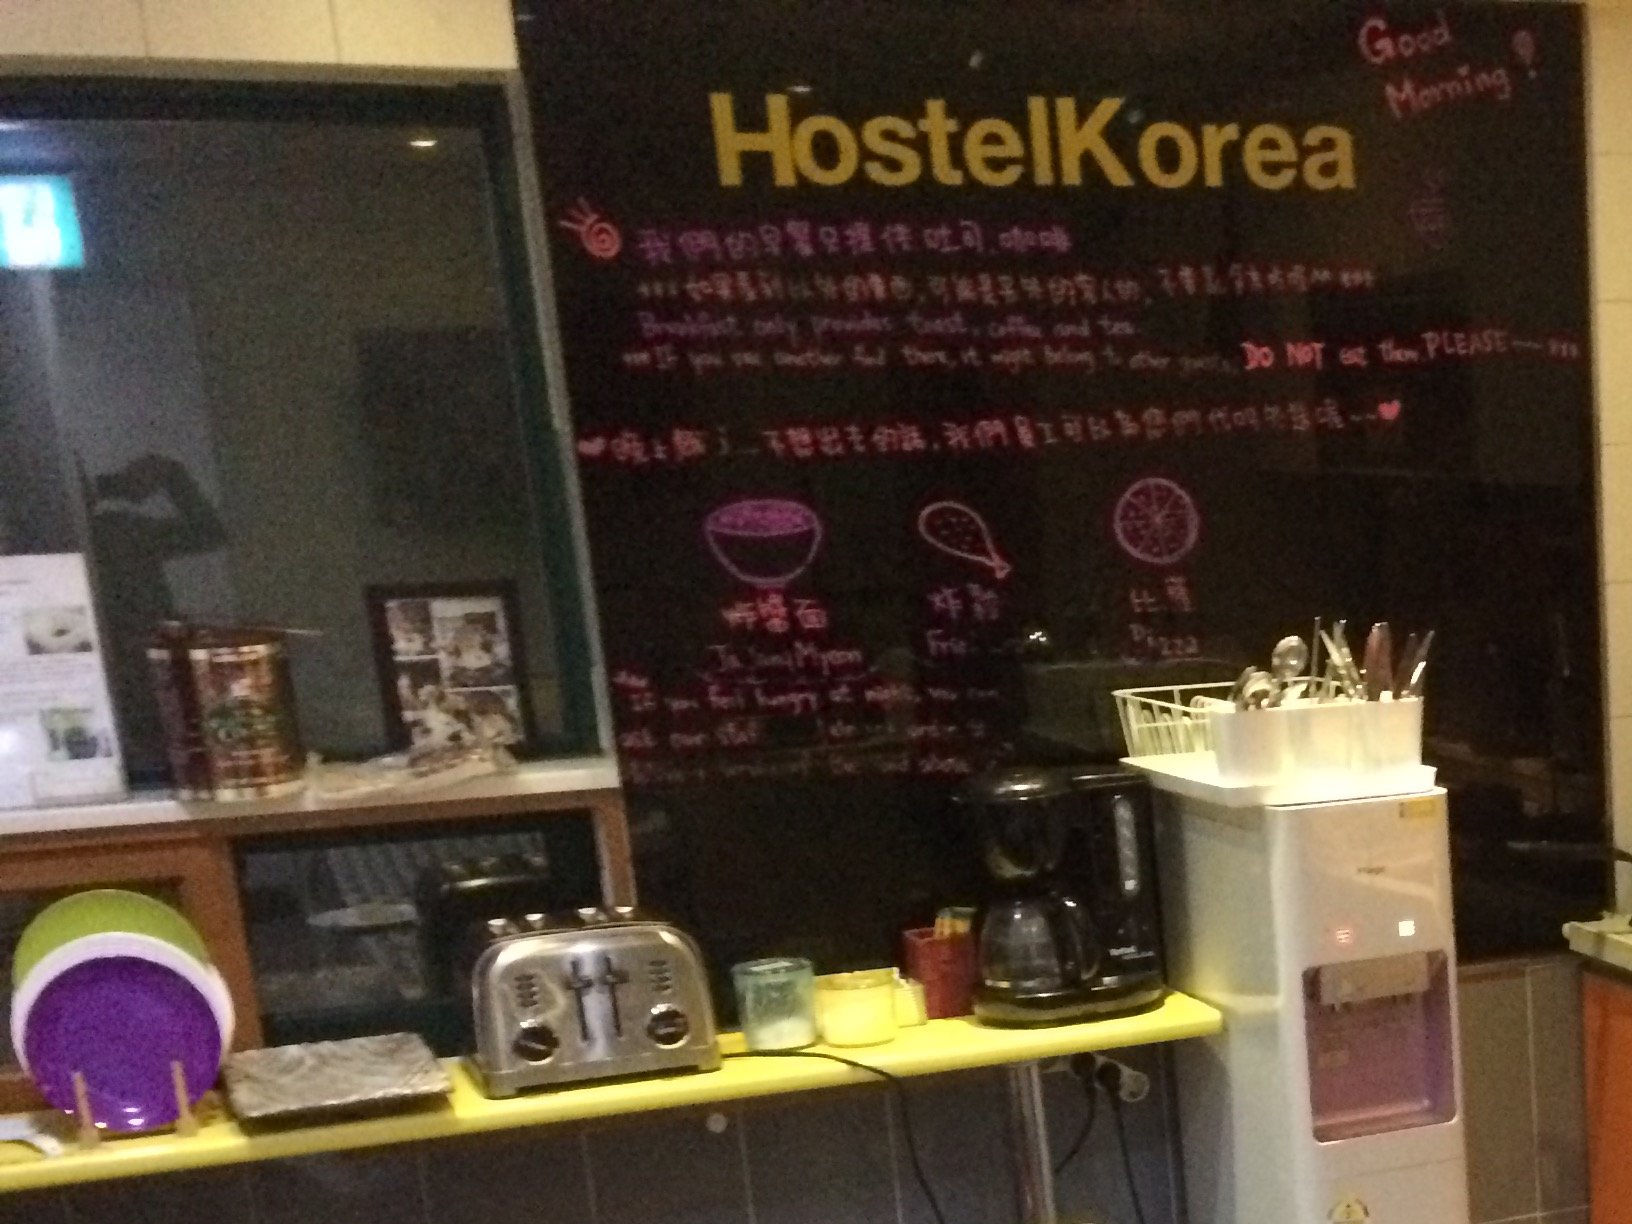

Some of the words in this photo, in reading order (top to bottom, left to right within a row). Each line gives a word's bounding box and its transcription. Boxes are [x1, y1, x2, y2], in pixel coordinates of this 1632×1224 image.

[1358, 9, 1453, 64] Good
[1385, 66, 1512, 118] Morning
[1241, 341, 1274, 370] DO
[1286, 341, 1326, 370] NOT
[1422, 330, 1509, 360] PLEASE
